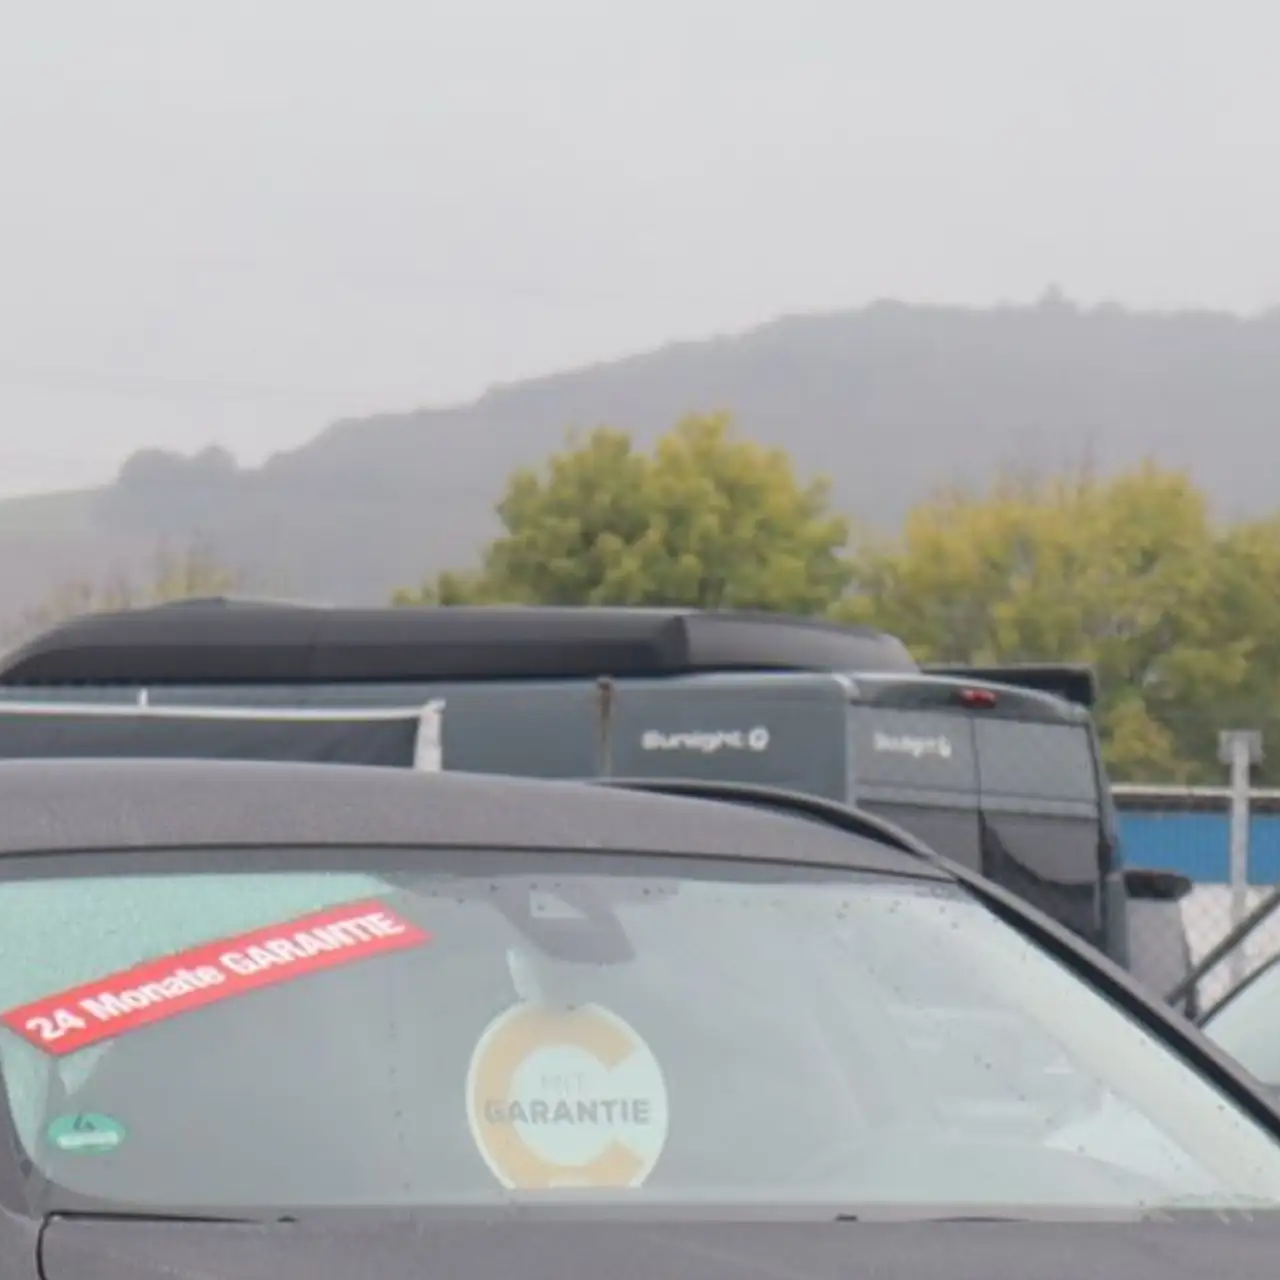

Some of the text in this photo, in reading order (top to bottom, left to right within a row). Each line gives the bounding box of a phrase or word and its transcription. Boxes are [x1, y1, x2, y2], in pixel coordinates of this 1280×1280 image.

[25, 911, 407, 1043] 24 Monate GARANTIE
[483, 1098, 652, 1126] GARANTIE
